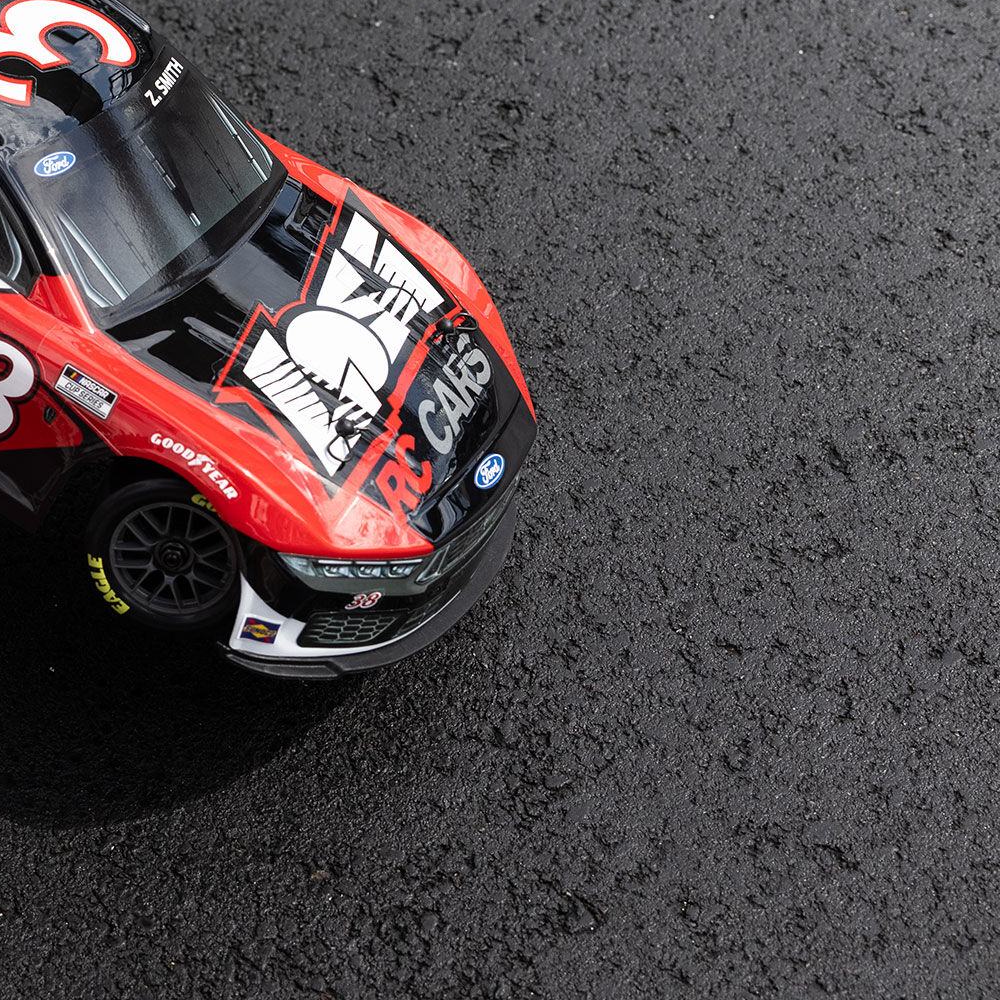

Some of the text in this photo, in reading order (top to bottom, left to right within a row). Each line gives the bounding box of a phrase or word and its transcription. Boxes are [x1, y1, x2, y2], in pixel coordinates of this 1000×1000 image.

[144, 57, 184, 107] Z. SMITH
[40, 154, 72, 174] Ford
[65, 381, 104, 409] CUP SERIES
[78, 375, 110, 399] NASCAR
[150, 433, 238, 500] GOODYEAR
[375, 434, 432, 520] RC
[479, 457, 503, 485] Ford
[87, 553, 130, 615] EAGLE
[344, 592, 381, 610] 38
